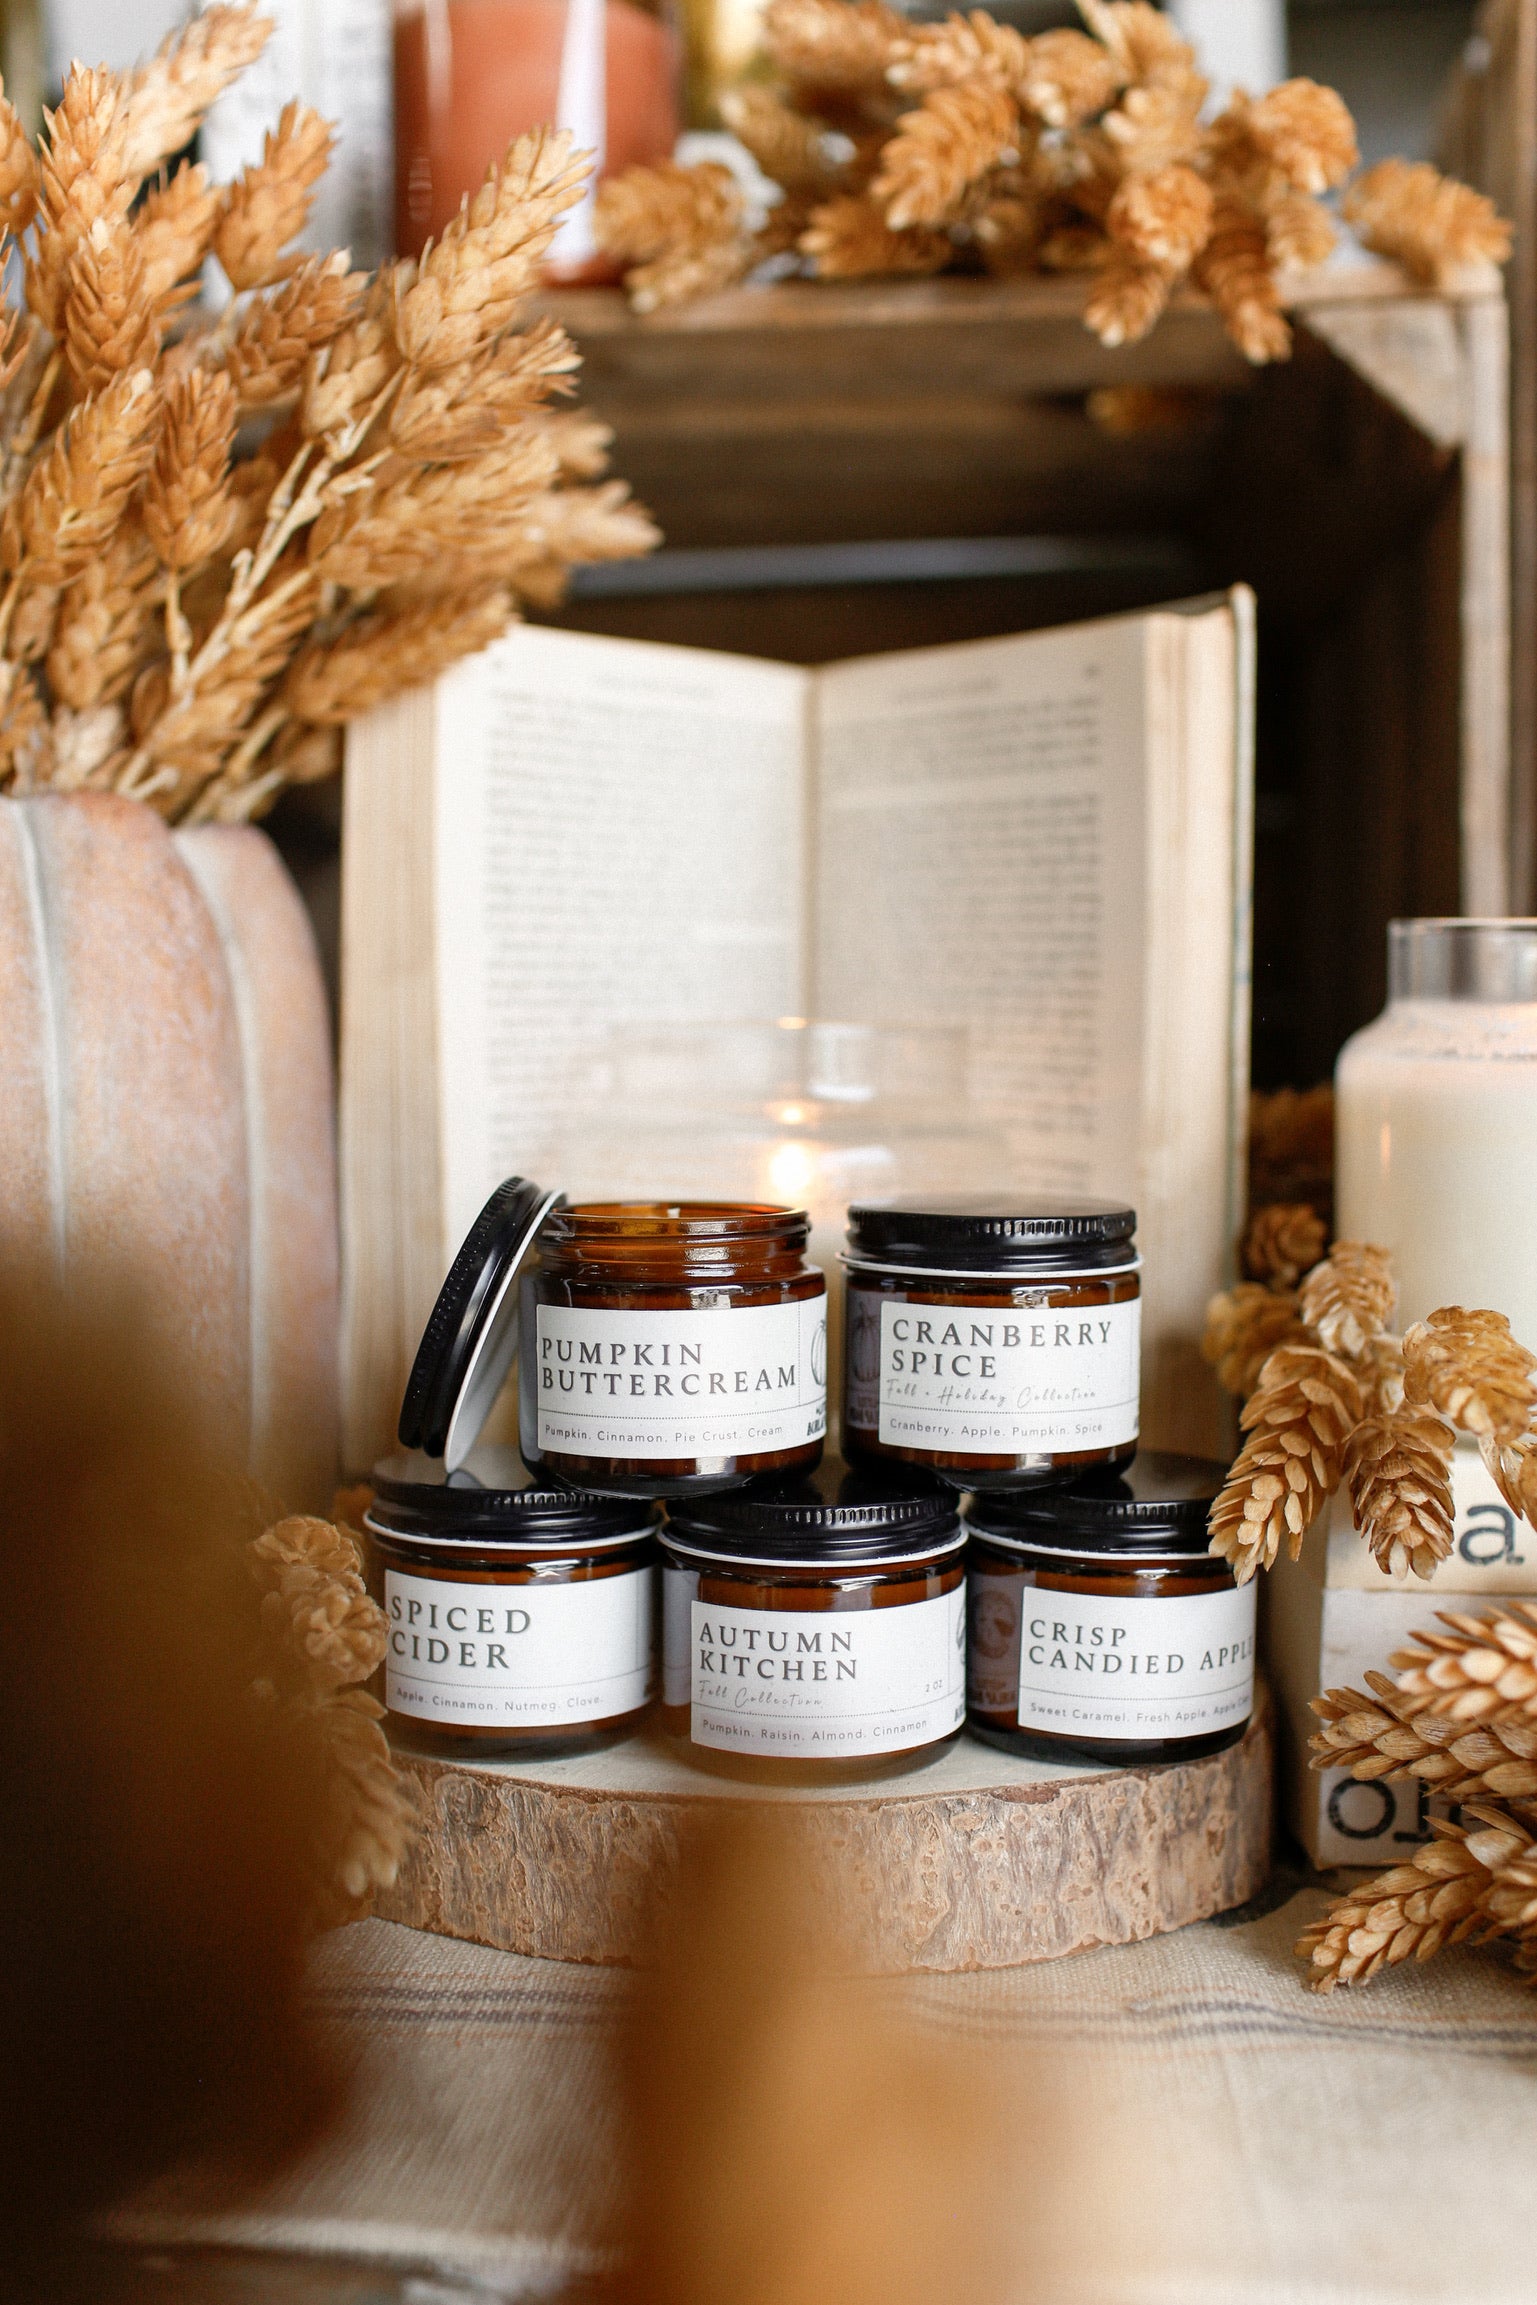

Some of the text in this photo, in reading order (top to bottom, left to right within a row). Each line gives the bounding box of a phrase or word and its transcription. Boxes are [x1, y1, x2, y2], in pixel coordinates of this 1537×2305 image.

[893, 1319, 1112, 1347] CRANBERRY
[542, 1337, 702, 1366] PUMPKIN
[892, 1350, 997, 1378] SPICE
[542, 1365, 796, 1396] BUTTERCREAM
[886, 1378, 1096, 1409] Fall Holiday Collection
[675, 1432, 696, 1443] Pie
[748, 1425, 783, 1438] Cream
[1075, 1422, 1103, 1436] Spice
[391, 1595, 532, 1635] SPICED
[699, 1622, 853, 1653] AUTUMN
[1030, 1619, 1127, 1648] CRISP
[391, 1630, 511, 1670] CIDER
[1029, 1645, 1185, 1674] CANDIED
[699, 1649, 857, 1682] KITCHEN
[698, 1680, 823, 1708] Fall Collection
[1031, 1702, 1067, 1719] Sweet
[1137, 1712, 1170, 1724] Fresh
[873, 1719, 928, 1737] Cinnamon
